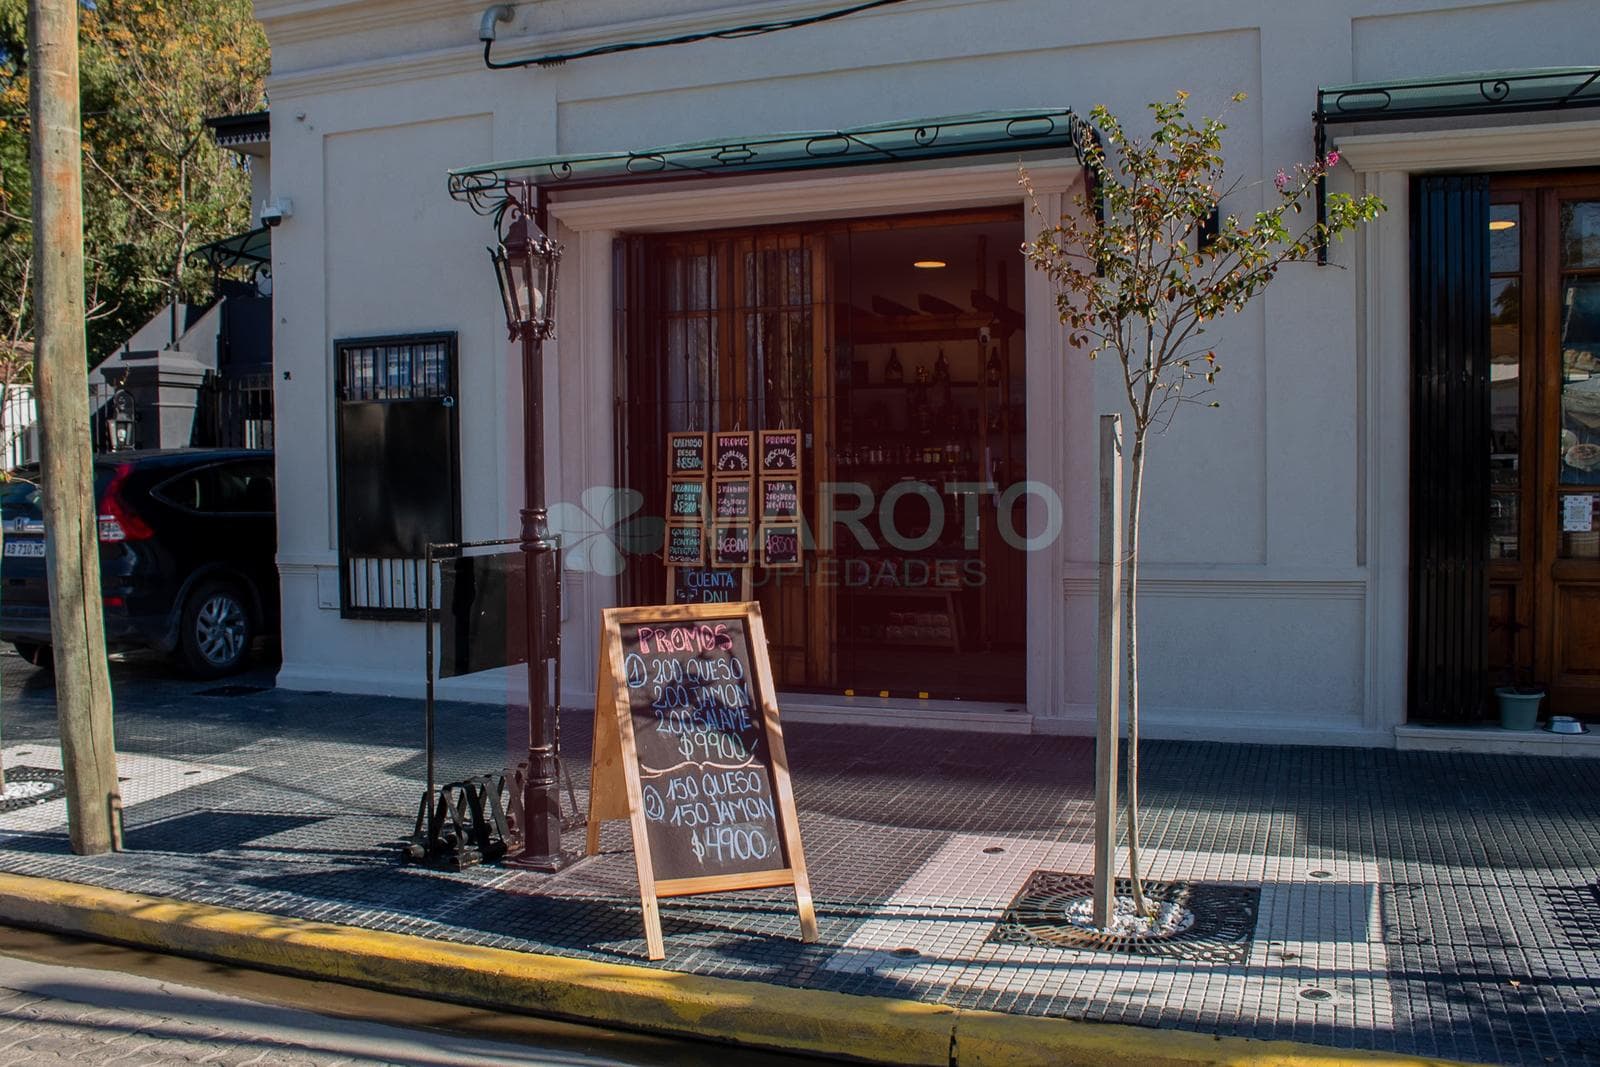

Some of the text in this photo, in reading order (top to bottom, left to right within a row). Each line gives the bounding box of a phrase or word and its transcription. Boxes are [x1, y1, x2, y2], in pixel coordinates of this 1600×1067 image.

[719, 437, 749, 447] PROMOS
[717, 536, 749, 554] $6800
[688, 571, 734, 588] CUENTA
[703, 589, 728, 603] DNI
[638, 624, 733, 654] PROMOS
[652, 659, 683, 684] 200
[686, 657, 743, 685] QUESO
[652, 682, 750, 710] 200 JAMON
[666, 775, 699, 801] 150
[702, 770, 761, 801] QUESO
[670, 795, 776, 828] 150 JAMON
